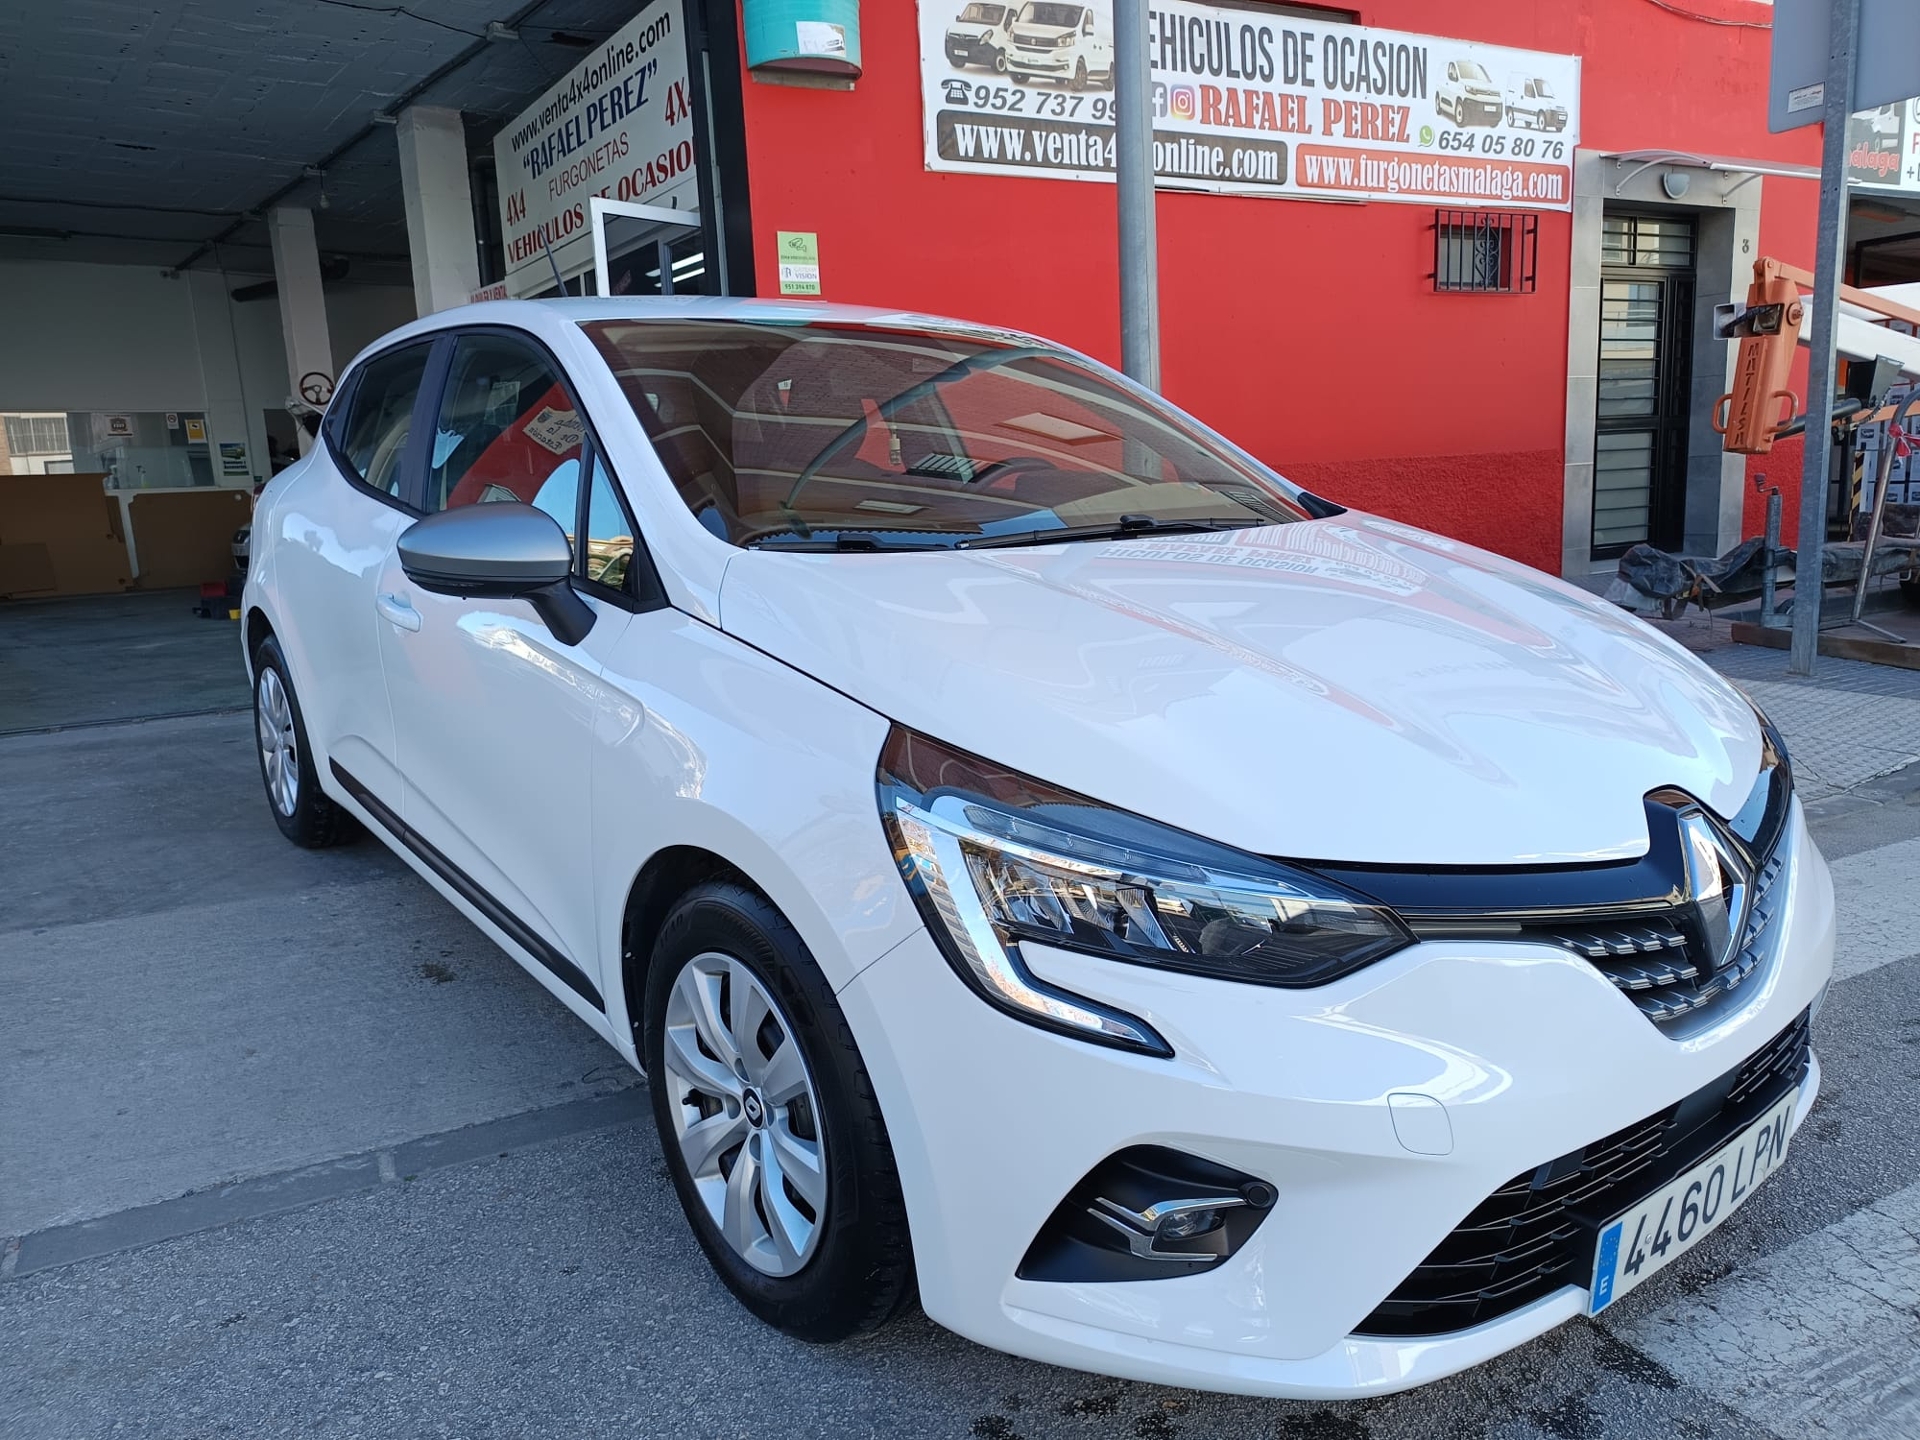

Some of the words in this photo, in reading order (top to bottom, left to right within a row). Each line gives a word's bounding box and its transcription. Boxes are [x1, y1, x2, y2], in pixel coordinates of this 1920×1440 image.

[511, 12, 671, 153] www.venta4x4online.com
[1149, 10, 1274, 83] EHICULOS
[1282, 29, 1315, 88] DE
[1323, 34, 1428, 100] OCASION
[973, 85, 1026, 113] 952
[1035, 91, 1084, 118] 737
[1200, 84, 1312, 135] RAFAEL
[1321, 98, 1411, 143] PEREZ
[506, 188, 527, 227] 4X4
[548, 132, 629, 201] FURGONETAS
[665, 76, 691, 127] 4X
[1304, 154, 1563, 200] www.furgonetasmalaga.com
[1438, 130, 1475, 152] 654
[1481, 134, 1506, 155] 05
[1511, 137, 1535, 158] 80
[1542, 140, 1564, 160] 76
[1849, 142, 1900, 177] álaga
[507, 203, 585, 264] VEHICULOS
[618, 136, 696, 203] OCASIO
[1734, 342, 1760, 445] MATILSA
[1623, 1164, 1725, 1276] 4460
[1731, 1105, 1791, 1204] LPN
[1599, 1275, 1610, 1296] E
